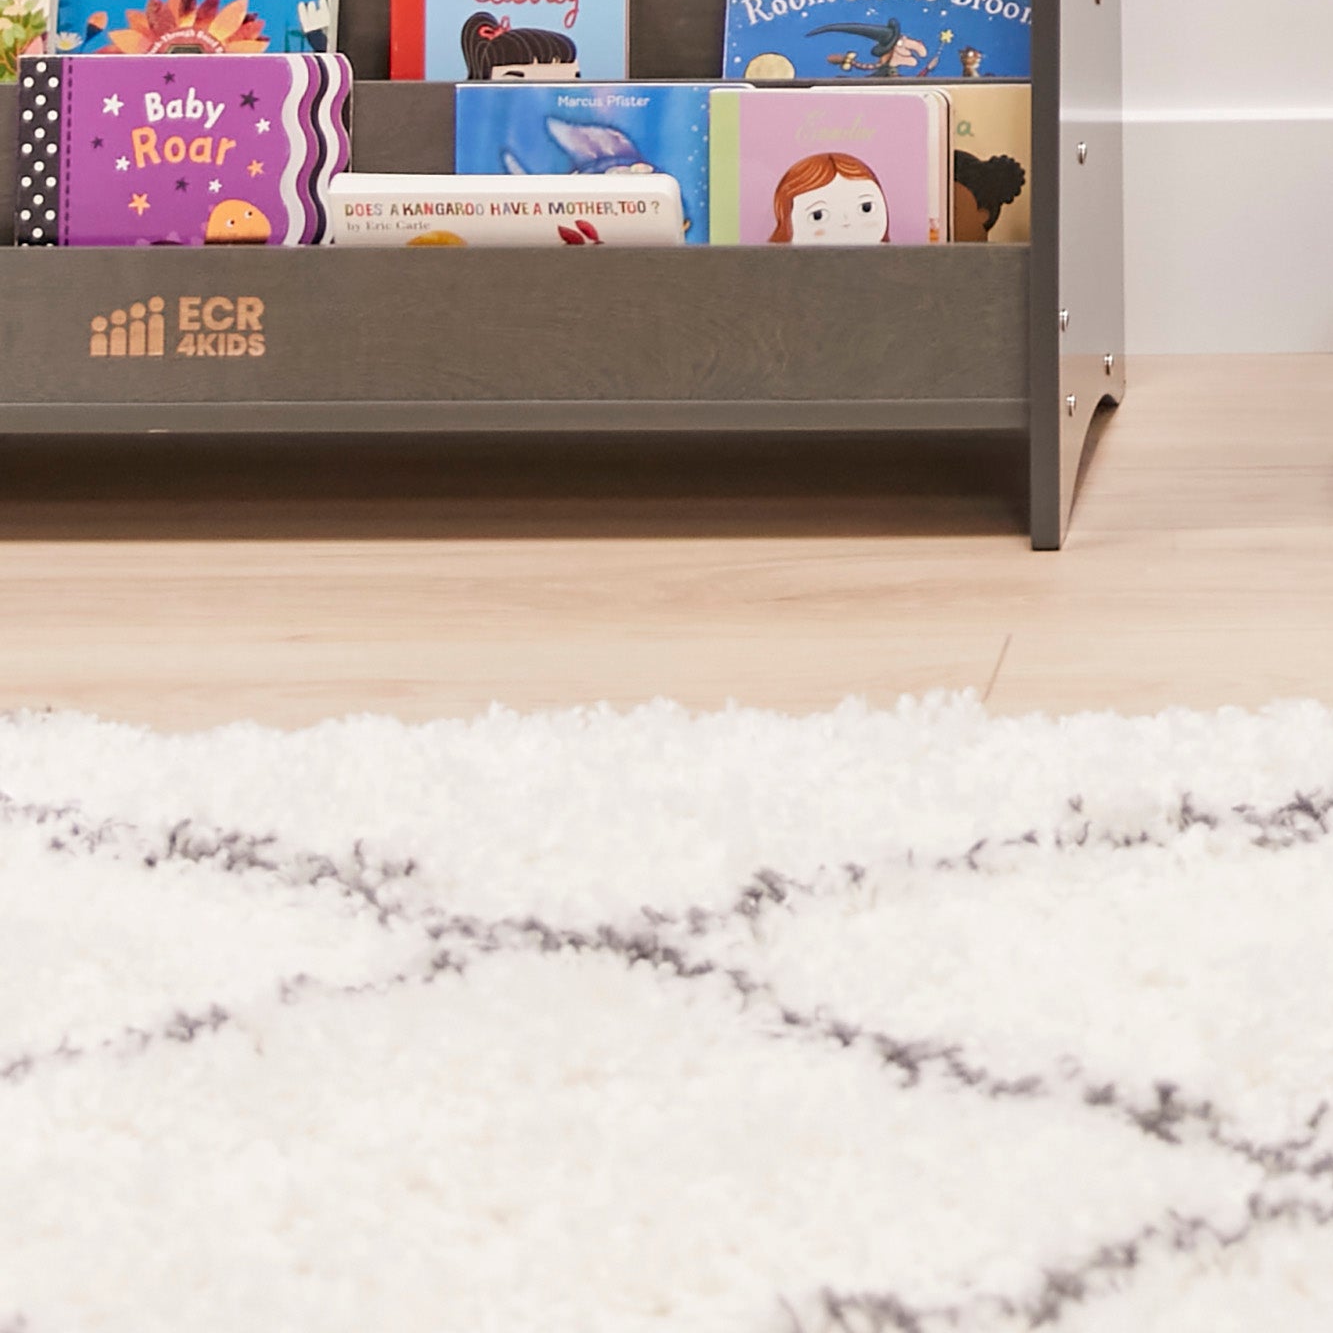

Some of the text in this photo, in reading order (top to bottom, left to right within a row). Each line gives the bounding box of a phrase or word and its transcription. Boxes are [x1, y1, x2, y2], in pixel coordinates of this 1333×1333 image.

[144, 86, 226, 129] Baby
[557, 95, 651, 108] Marcus Pfister
[131, 126, 237, 169] Roar
[345, 203, 383, 217] DOES
[390, 203, 399, 216] A
[402, 202, 485, 217] KANGAROO
[490, 202, 529, 216] HAVE
[533, 202, 542, 216] A
[346, 219, 431, 233] by Eric Carle
[178, 295, 265, 331] ECR
[176, 333, 266, 357] 4KIDS
